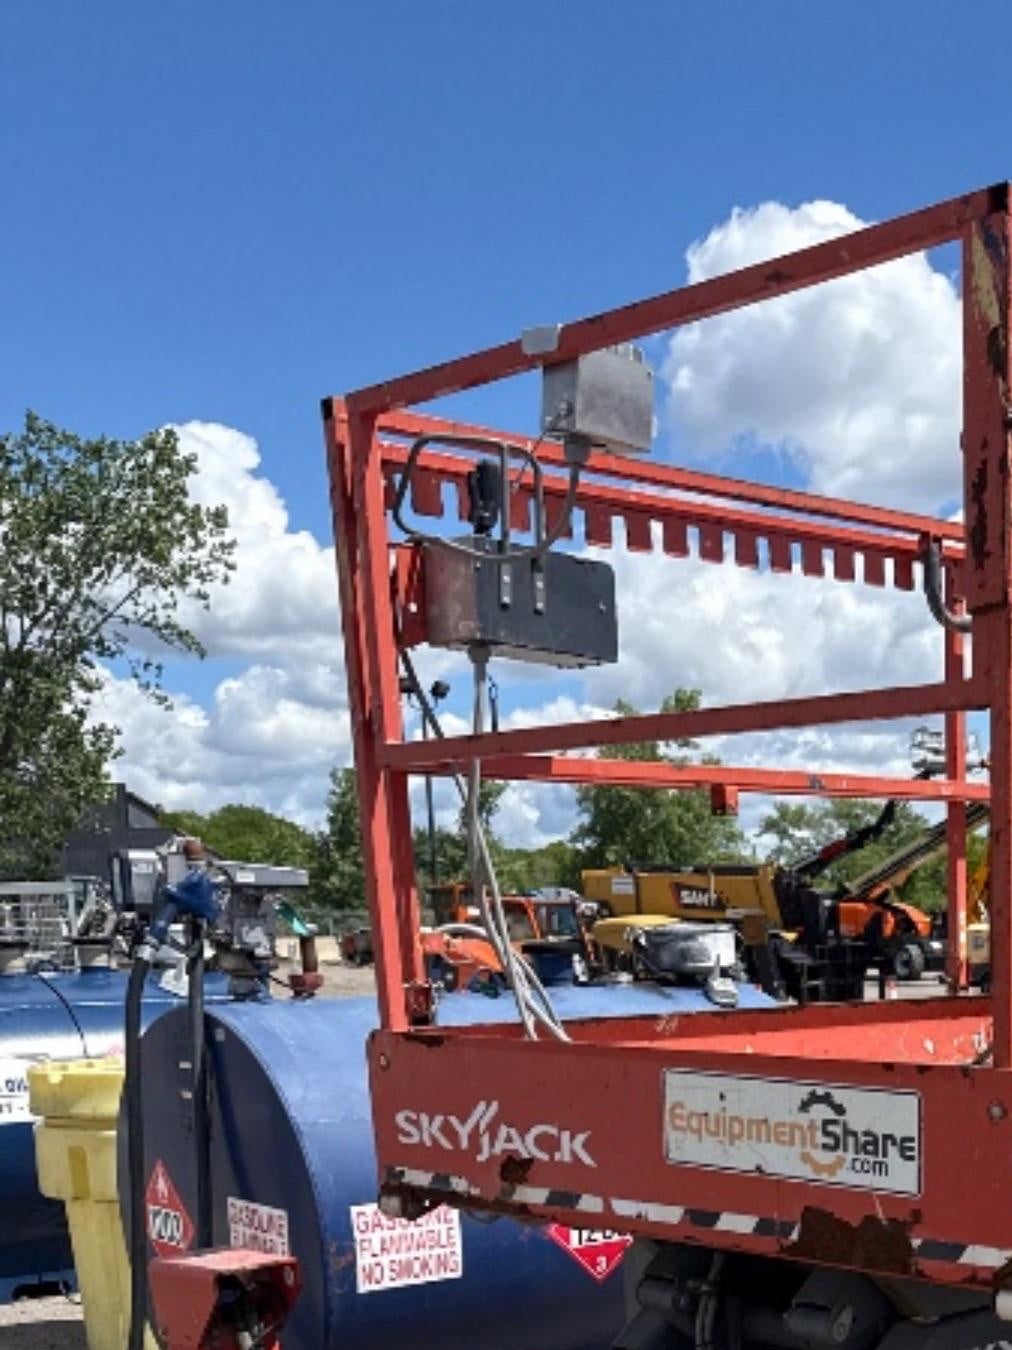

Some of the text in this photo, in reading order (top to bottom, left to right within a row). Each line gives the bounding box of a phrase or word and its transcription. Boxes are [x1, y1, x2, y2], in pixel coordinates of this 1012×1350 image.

[395, 1101, 597, 1167] SKYJACK
[669, 1101, 917, 1162] EquipmentShare
[847, 1156, 889, 1178] .com
[361, 1251, 459, 1285] NO SMOKING
[595, 1255, 608, 1273] 3
